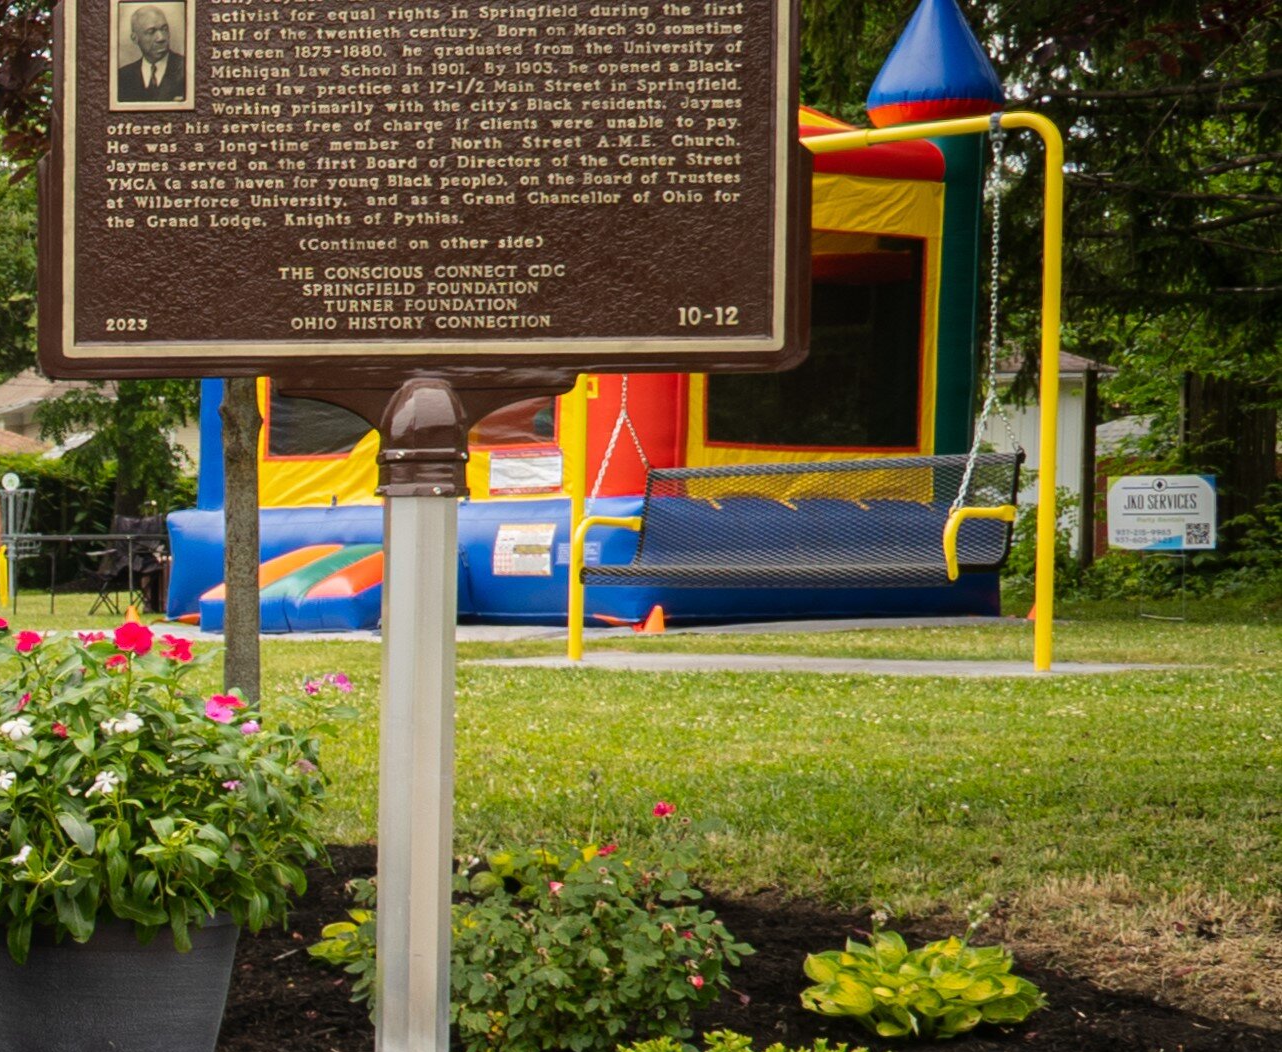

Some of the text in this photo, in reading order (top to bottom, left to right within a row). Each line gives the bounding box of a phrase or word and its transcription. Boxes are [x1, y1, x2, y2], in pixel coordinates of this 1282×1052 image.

[212, 2, 742, 24] activist for equal rights in Springfield during the first
[212, 21, 742, 42] half of the twentieth century. Born on March 30 sometime
[211, 40, 742, 60] between he graduated from the University of
[211, 59, 742, 81] Michigan Law School in 1901. By he opened Black-
[212, 78, 741, 99] owned law practice at 17-1/2 Main Street in Springfield.
[212, 96, 741, 118] Working primarily with the city's Black Jaymes
[107, 116, 740, 135] offered his services free of charge if clients were unable to pay.
[107, 134, 740, 155] He was long-time member of North Street A.M.E. Church.
[107, 153, 741, 175] Jaymes served on the first Board of Directors of the Center Street
[107, 171, 740, 191] YMCA (a safe haven for young Black on the Board of Trustees
[107, 190, 740, 208] at Wilberforce and as a Grand Chancellor of Ohio for
[106, 211, 463, 229] the Grand Knights of Pythias.
[299, 235, 543, 251] (Continued on other side)
[279, 265, 564, 280] THE CONSCIOUS CONNECT CDC
[303, 282, 538, 296] SPRINGFIELD FOUNDATION
[324, 299, 516, 313] TURNER FOUNDATION
[107, 319, 147, 332] 2023
[291, 315, 550, 331] OHIO HISTORY CONNECTION
[678, 307, 738, 326] 10-12
[1124, 493, 1197, 510] JKO SERVICES
